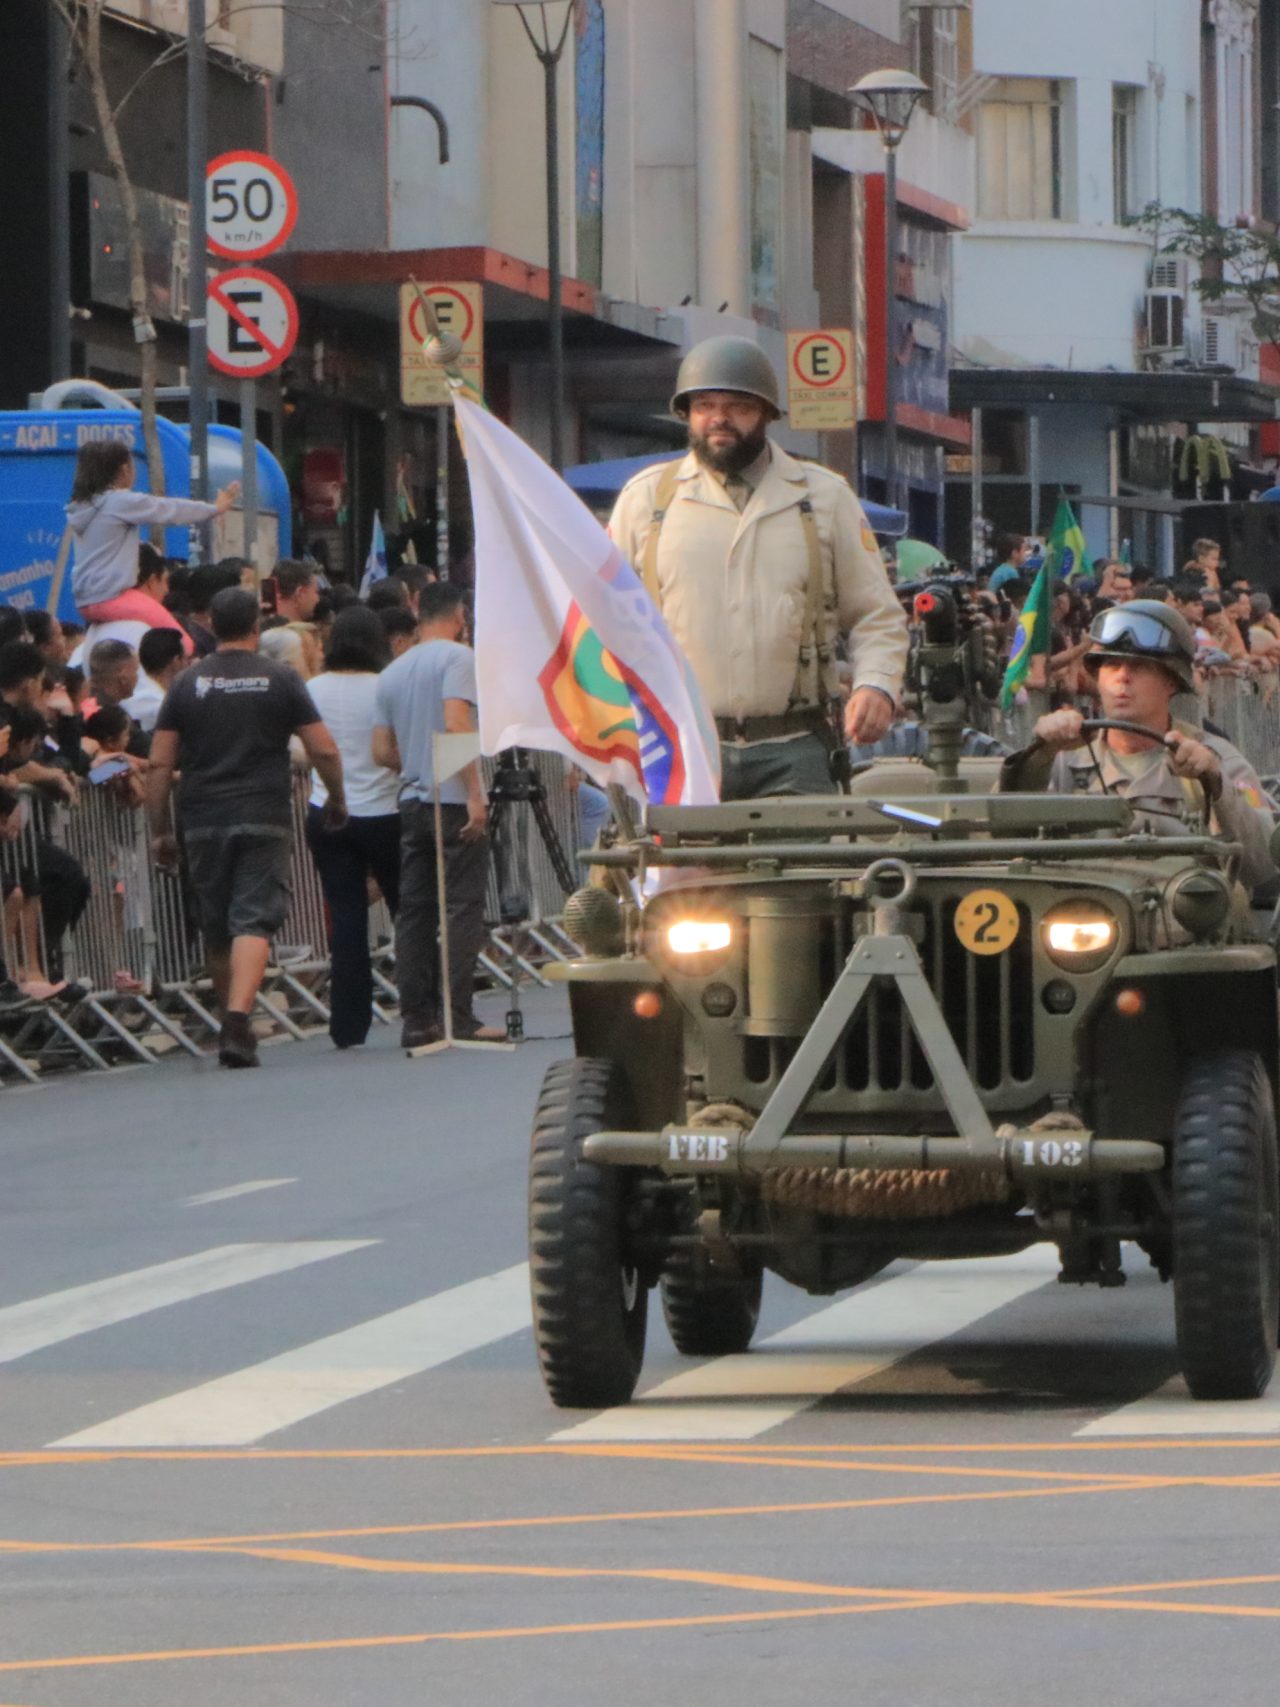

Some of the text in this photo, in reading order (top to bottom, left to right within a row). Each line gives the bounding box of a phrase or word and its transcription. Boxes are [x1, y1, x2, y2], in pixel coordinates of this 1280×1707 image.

[211, 178, 274, 223] 50
[224, 230, 264, 242] km/h
[227, 291, 264, 353] E
[812, 346, 830, 376] E
[16, 421, 58, 450] AÇAÍ
[973, 902, 1000, 943] 2
[669, 1134, 730, 1161] FEB
[1022, 1140, 1083, 1168] 103
